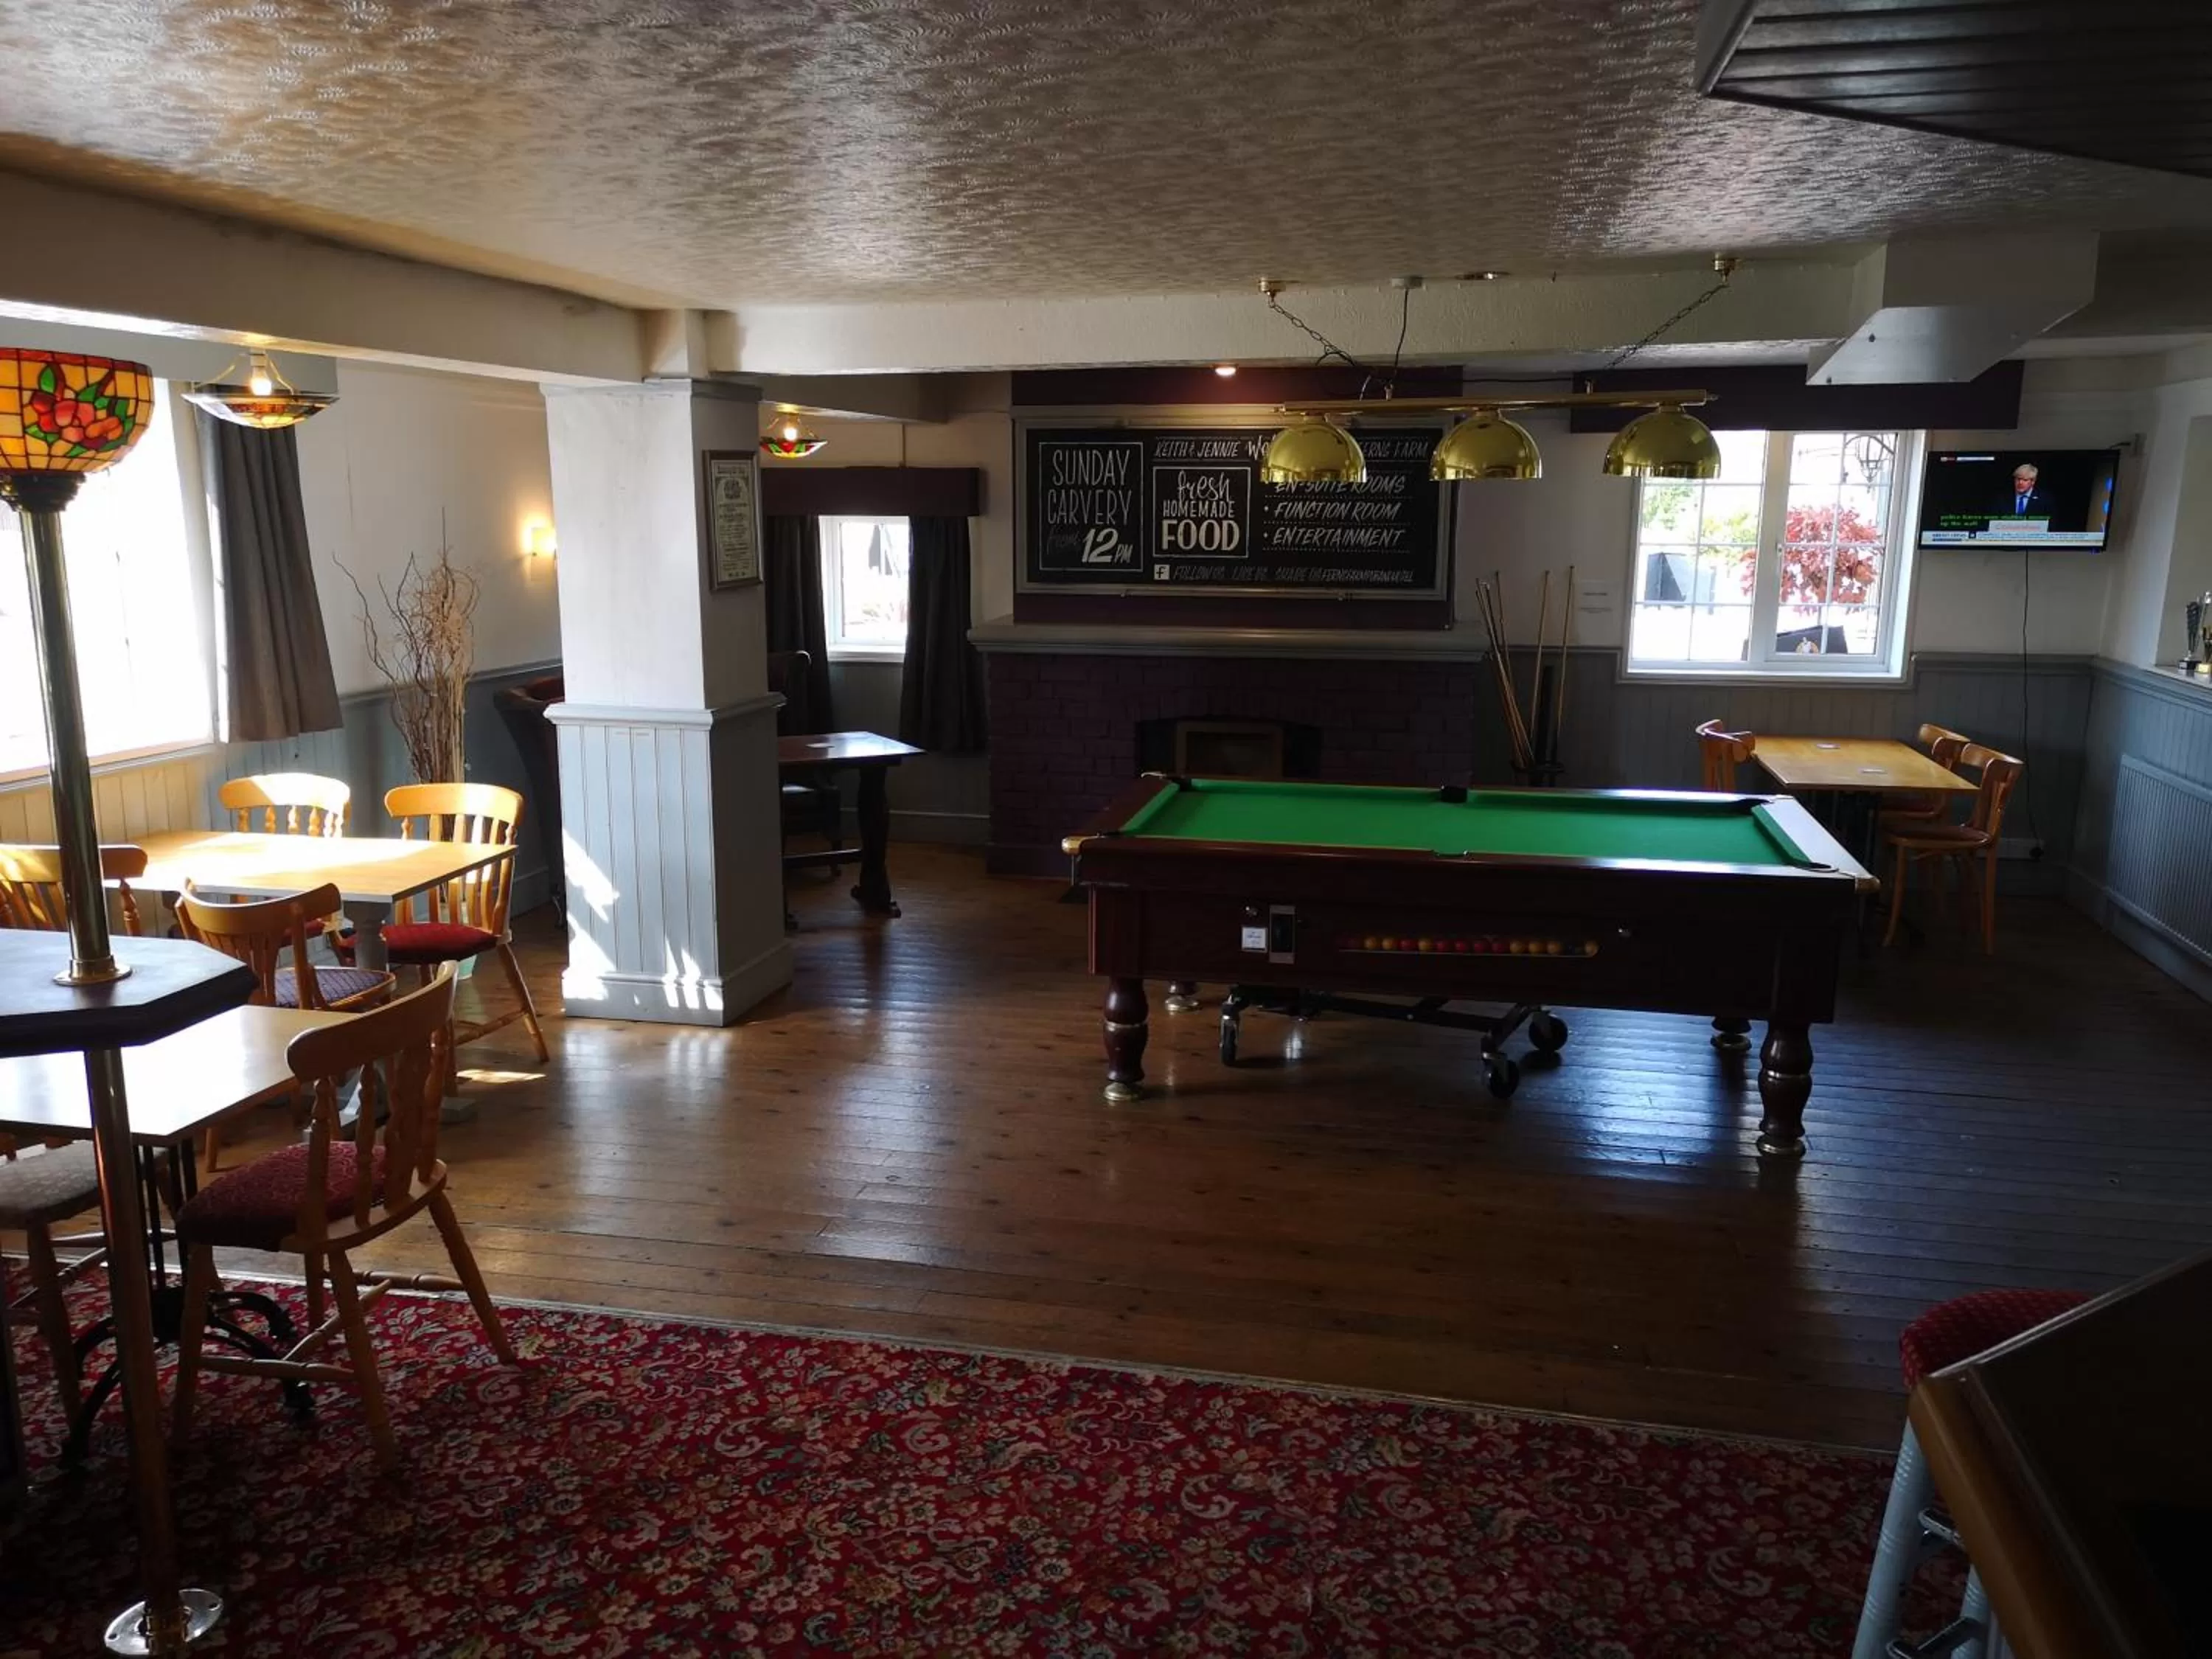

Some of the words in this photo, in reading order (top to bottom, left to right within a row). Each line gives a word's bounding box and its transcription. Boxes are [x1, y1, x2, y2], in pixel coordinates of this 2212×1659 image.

[1154, 440, 1189, 458] KEITH
[1197, 440, 1240, 458] JENNIE
[1393, 440, 1428, 458] FARM
[1052, 449, 1130, 485] SUNDAY
[1177, 470, 1231, 504] fresh
[1350, 474, 1405, 494] ROOMS
[1047, 489, 1133, 525] CARVERY
[1163, 499, 1236, 517] HOMEMADE
[1273, 501, 1351, 519] FUNCTION
[1350, 501, 1401, 521] ROOM
[1081, 528, 1119, 563] 12
[1114, 543, 1133, 563] PM
[1161, 519, 1240, 551] FOOD
[1273, 526, 1406, 547] ENTERTAINMENT
